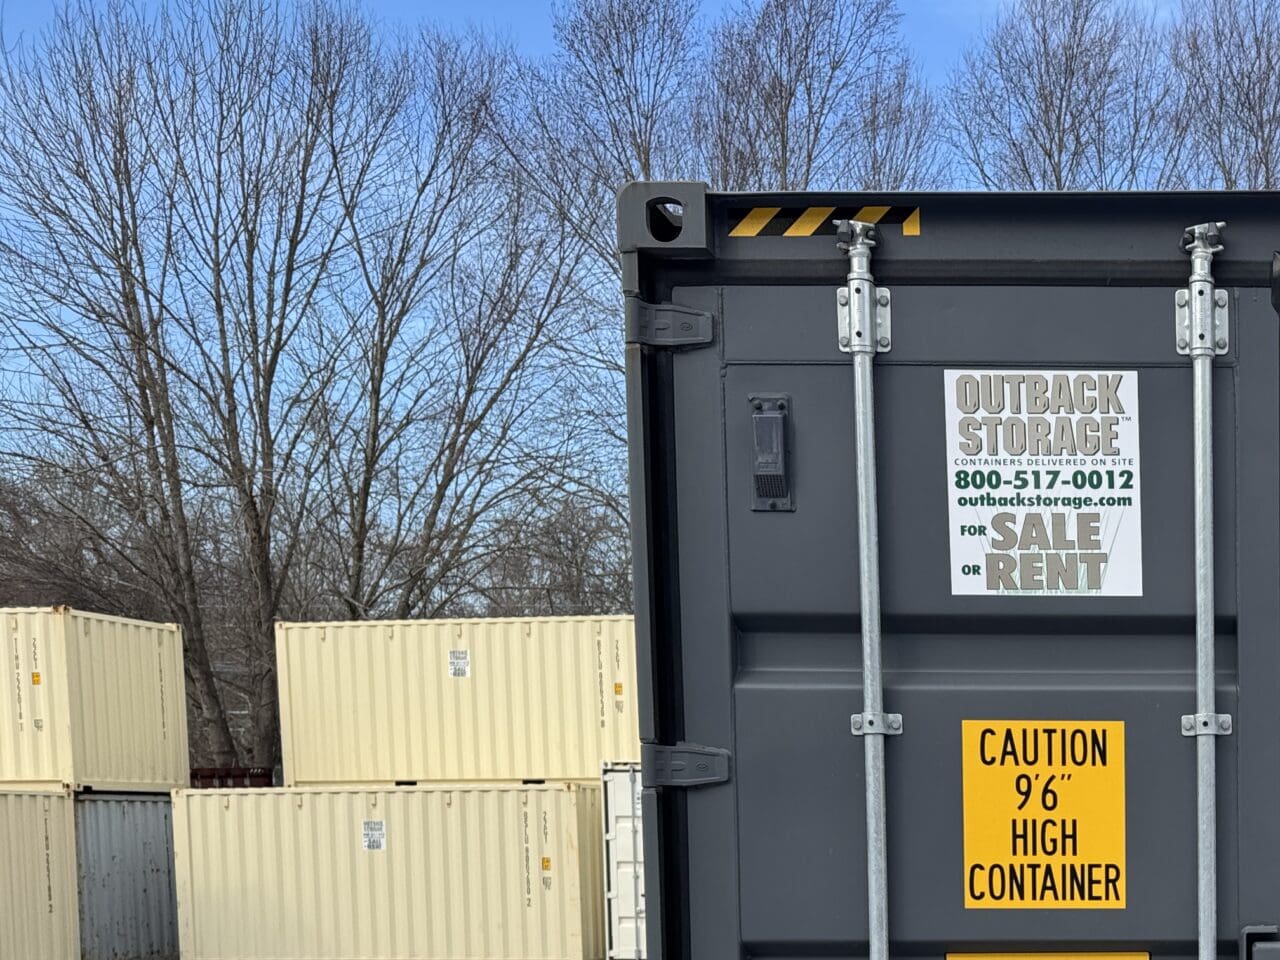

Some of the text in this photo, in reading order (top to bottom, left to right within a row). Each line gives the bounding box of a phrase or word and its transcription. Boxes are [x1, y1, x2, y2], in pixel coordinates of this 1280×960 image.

[956, 374, 1125, 414] OUTBACK
[958, 416, 1120, 456] STORAGE
[954, 458, 1134, 466] CONTAINERS DELIVERED ON SITE
[954, 470, 1134, 490] 800-517-0012
[957, 492, 1132, 510] outbackstorage.com
[960, 512, 1102, 551] FOR SALE
[961, 552, 1108, 590] OR RENT
[979, 728, 1108, 766] CAUTION
[1012, 818, 1078, 856] HIGH
[968, 863, 1121, 901] CONTAINER
